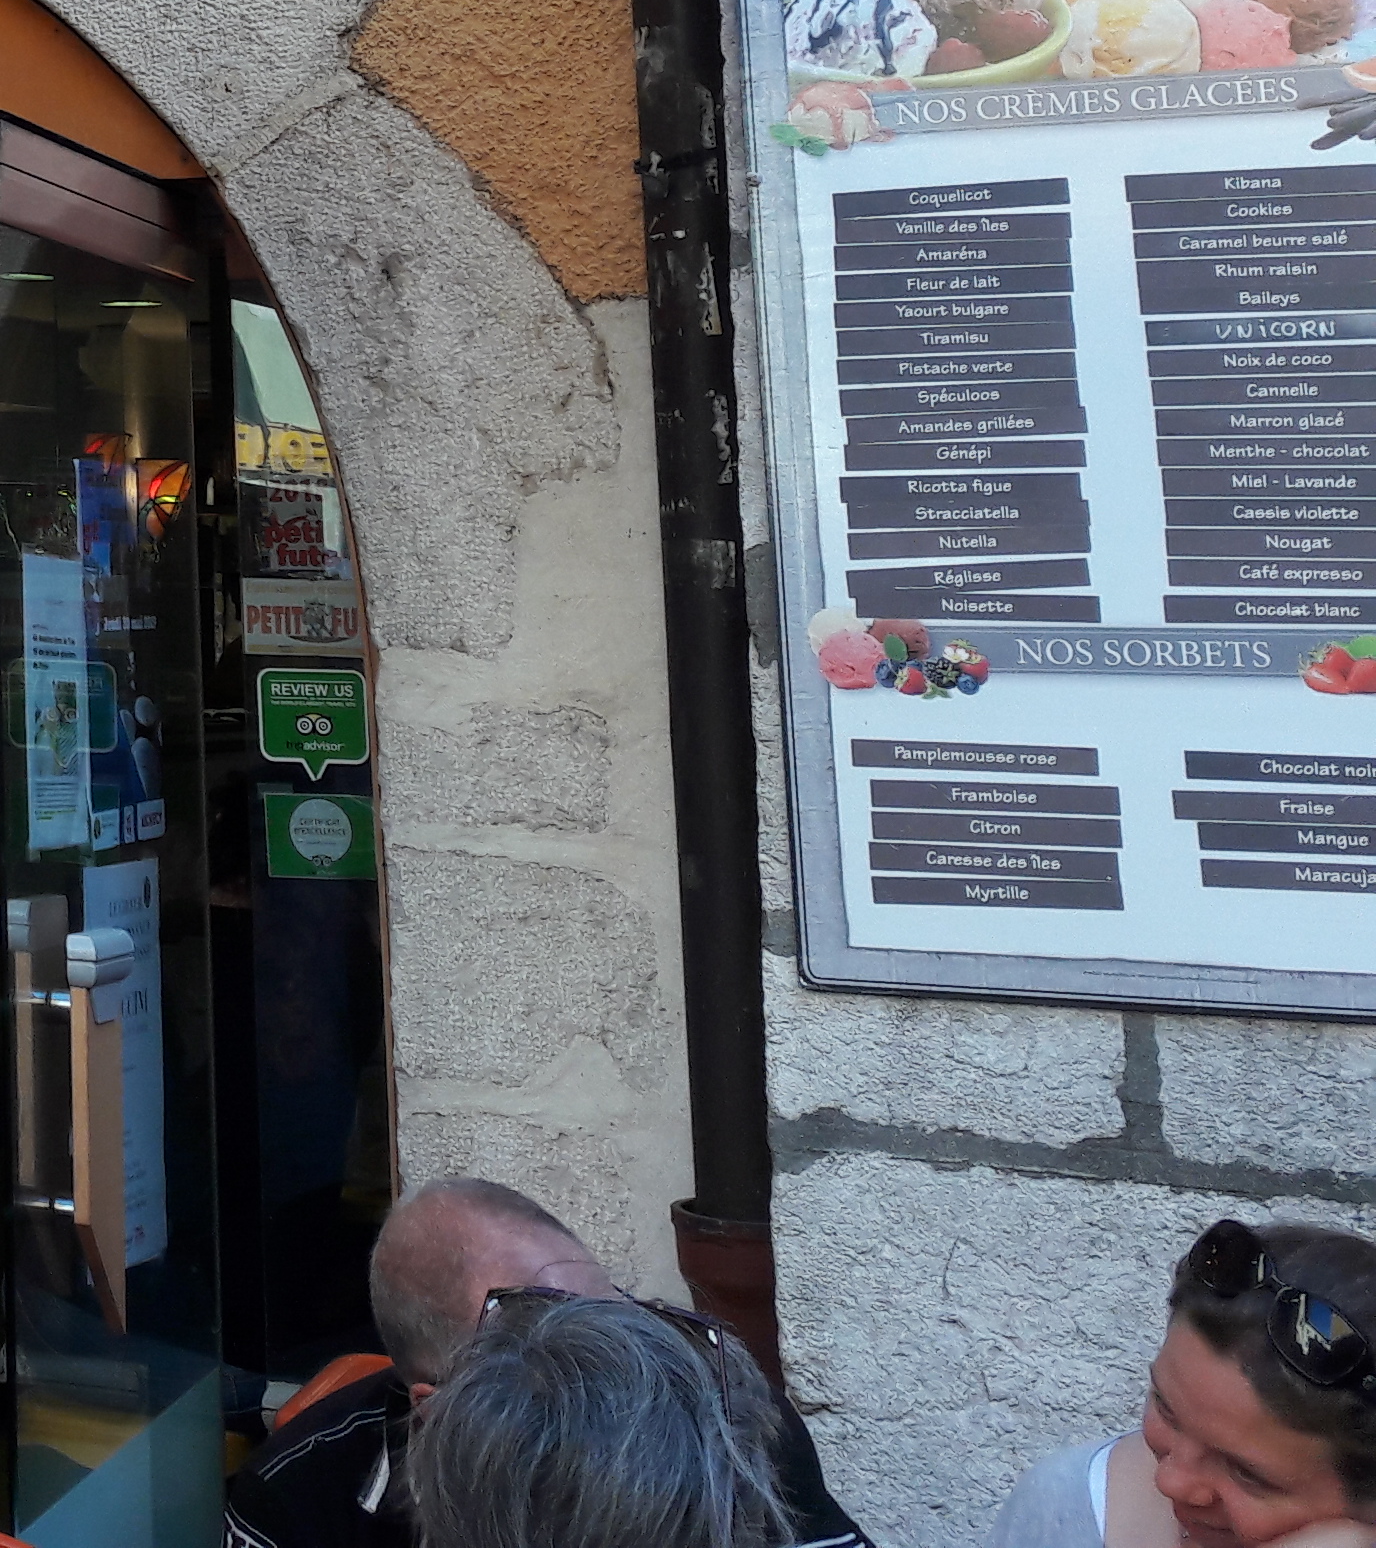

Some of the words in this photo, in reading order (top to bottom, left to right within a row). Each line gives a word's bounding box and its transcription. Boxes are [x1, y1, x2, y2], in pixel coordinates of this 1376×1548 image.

[896, 95, 967, 125] NOS
[975, 86, 1121, 121] CRÈMES
[1130, 75, 1300, 110] GLACÉES
[1224, 177, 1282, 190] Kibana
[909, 188, 992, 207] Coquelicot
[1227, 204, 1293, 217] Cookies
[896, 221, 944, 234] Vanille
[949, 220, 978, 232] des
[1178, 235, 1247, 250] Caramel
[1252, 234, 1306, 247] beurre
[1311, 228, 1348, 245] salé
[916, 246, 987, 261] Amaréna
[1215, 263, 1264, 277] Rhum
[1269, 262, 1318, 276] raisin
[907, 278, 946, 291] Fleur
[950, 276, 970, 290] de
[973, 274, 1001, 288] lait
[1239, 291, 1300, 307] Baileys
[895, 304, 948, 318] Yaourt
[952, 302, 1009, 319] bulgare
[920, 331, 989, 345] Tiramisu
[898, 361, 968, 375] Pistache
[971, 361, 1013, 373] verte
[1224, 354, 1262, 367] Noix
[1265, 353, 1287, 366] de
[1291, 354, 1332, 366] coco
[918, 389, 1000, 407] Spéculoos
[1246, 382, 1319, 397] Cannelle
[898, 418, 973, 434] Amandes
[977, 415, 1035, 432] grillées
[1230, 414, 1293, 428] Marron
[1298, 410, 1345, 430] glacé
[936, 445, 992, 464] Génépi
[1209, 444, 1276, 458] Menthe
[1292, 443, 1370, 458] chocolat
[907, 480, 967, 494] Ricotta
[972, 479, 1012, 495] figue
[1231, 473, 1268, 488] Miel
[1284, 473, 1358, 489] Lavande
[915, 505, 1020, 521] Stracciatella
[1233, 505, 1291, 519] Cassis
[1294, 506, 1360, 520] violette
[263, 514, 326, 549] peti
[939, 535, 997, 549] Nutella
[1265, 534, 1333, 552] Nougat
[933, 569, 1002, 588] Réglisse
[1239, 564, 1279, 580] Café
[1283, 568, 1364, 585] expresso
[942, 598, 1014, 613] Noisette
[1234, 601, 1311, 617] Chocolat
[1314, 603, 1362, 618] blanc
[246, 605, 304, 635] PETIT
[1016, 637, 1093, 666] NOS
[1103, 640, 1273, 669] SORBETS
[271, 683, 329, 697] REVIEW
[334, 684, 354, 697] US
[894, 745, 1016, 766] Pamplemousse
[1020, 753, 1058, 766] rose
[1260, 758, 1341, 777] Chocolat
[951, 788, 1038, 805] Framboise
[1280, 799, 1335, 816] Fraise
[969, 819, 1022, 836] Citron
[1298, 829, 1369, 849] Mangue
[926, 850, 992, 868] Caresse
[996, 852, 1028, 869] des
[1295, 866, 1376, 887] Maracuja
[965, 883, 1030, 902] Myrtille
